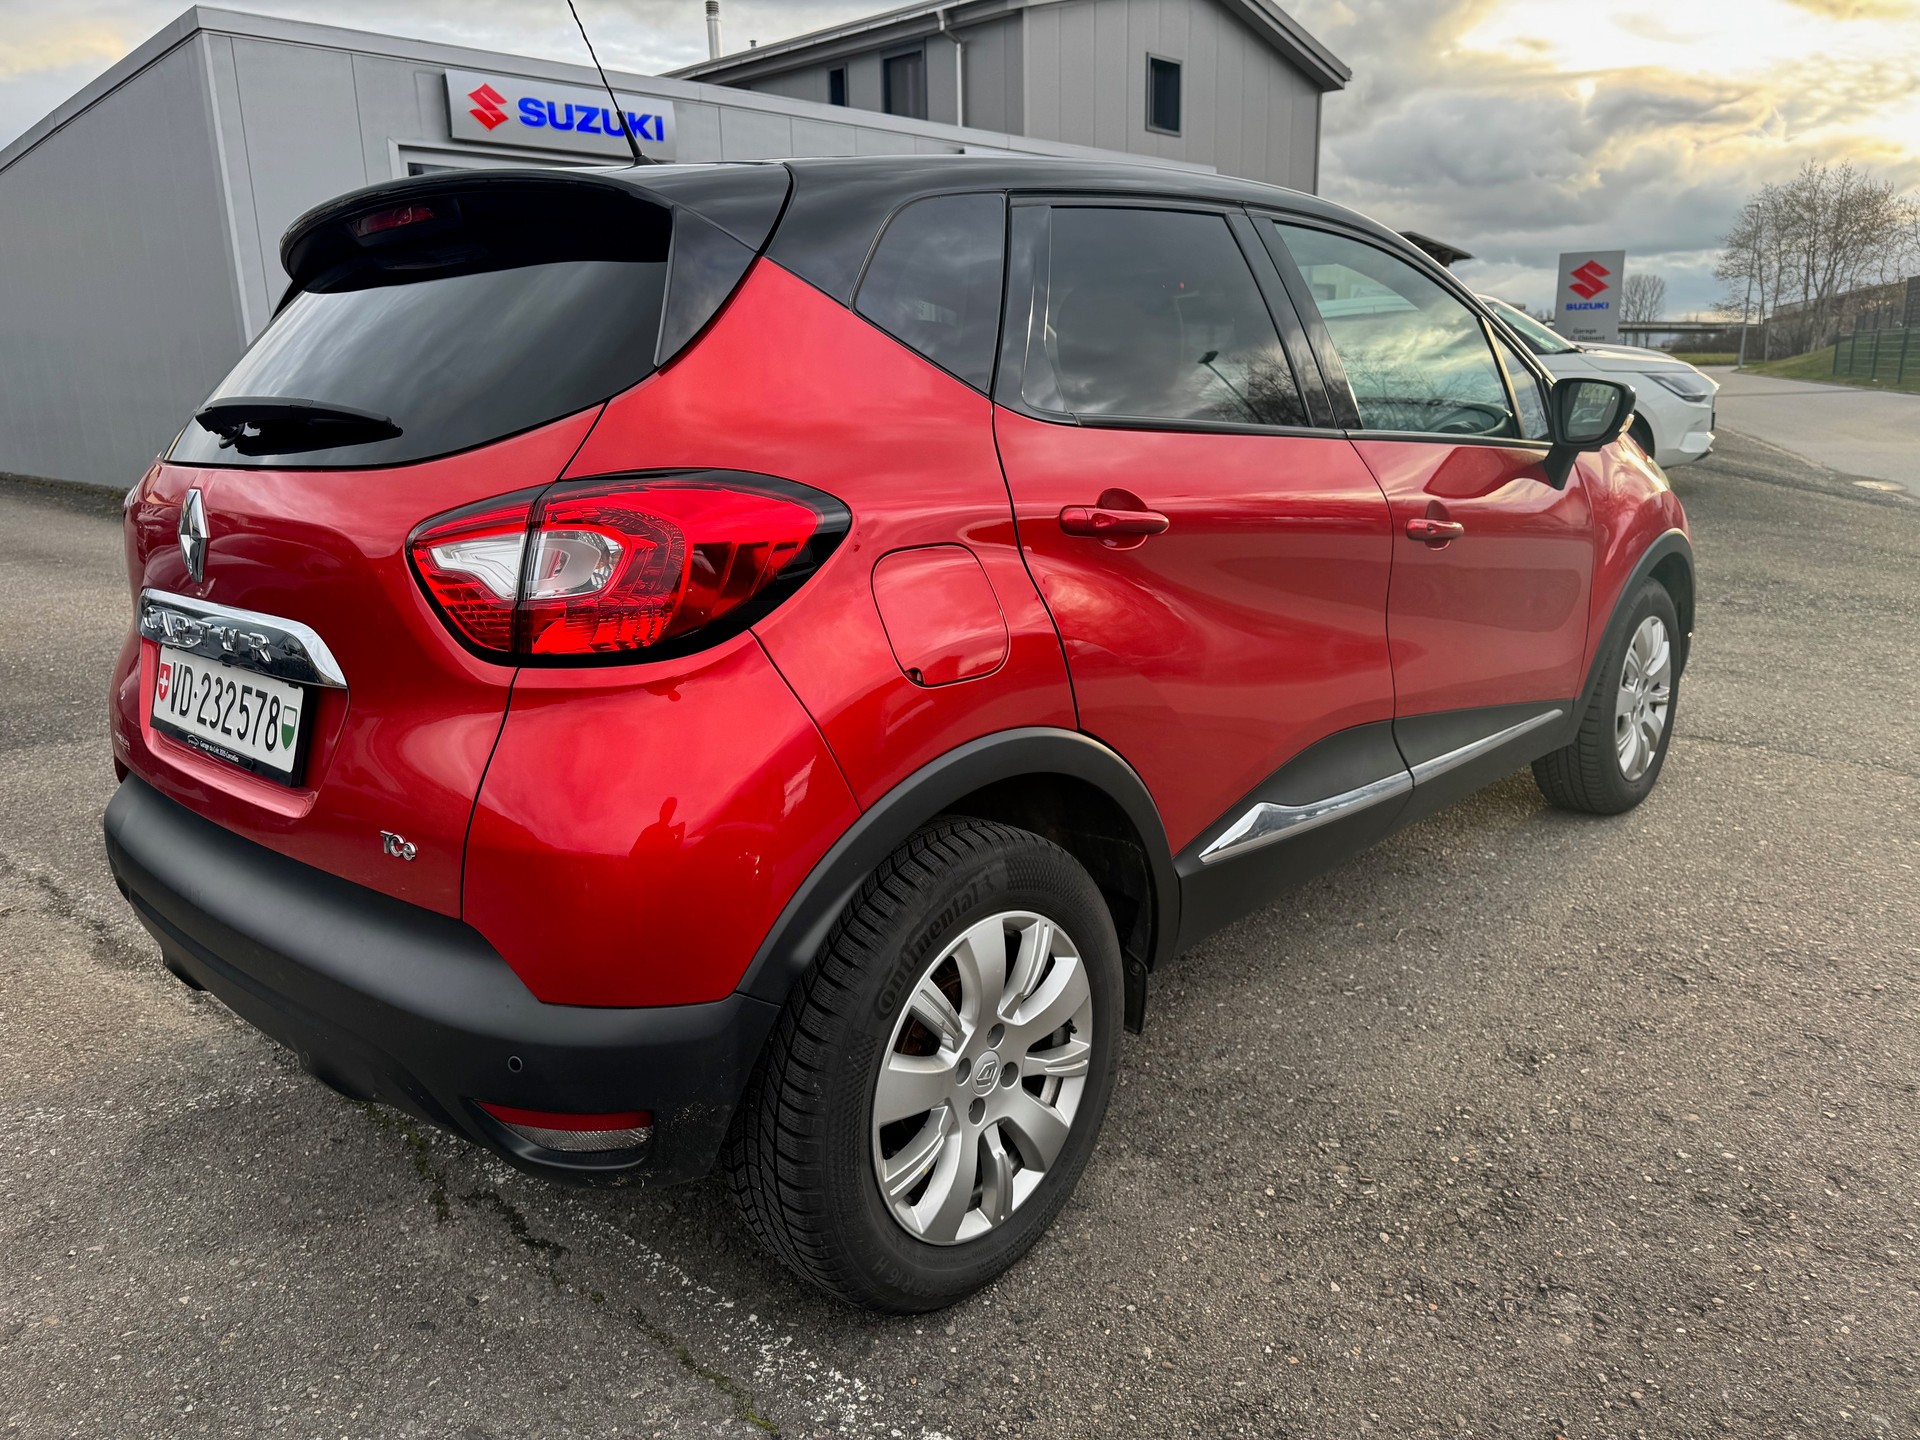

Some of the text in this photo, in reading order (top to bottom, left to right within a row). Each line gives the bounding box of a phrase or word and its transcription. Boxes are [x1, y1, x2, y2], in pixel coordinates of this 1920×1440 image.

[517, 96, 665, 142] SUZUKI
[1565, 302, 1610, 311] SUZUKI
[142, 606, 273, 664] CAPTUR
[873, 880, 980, 1021] Continental
